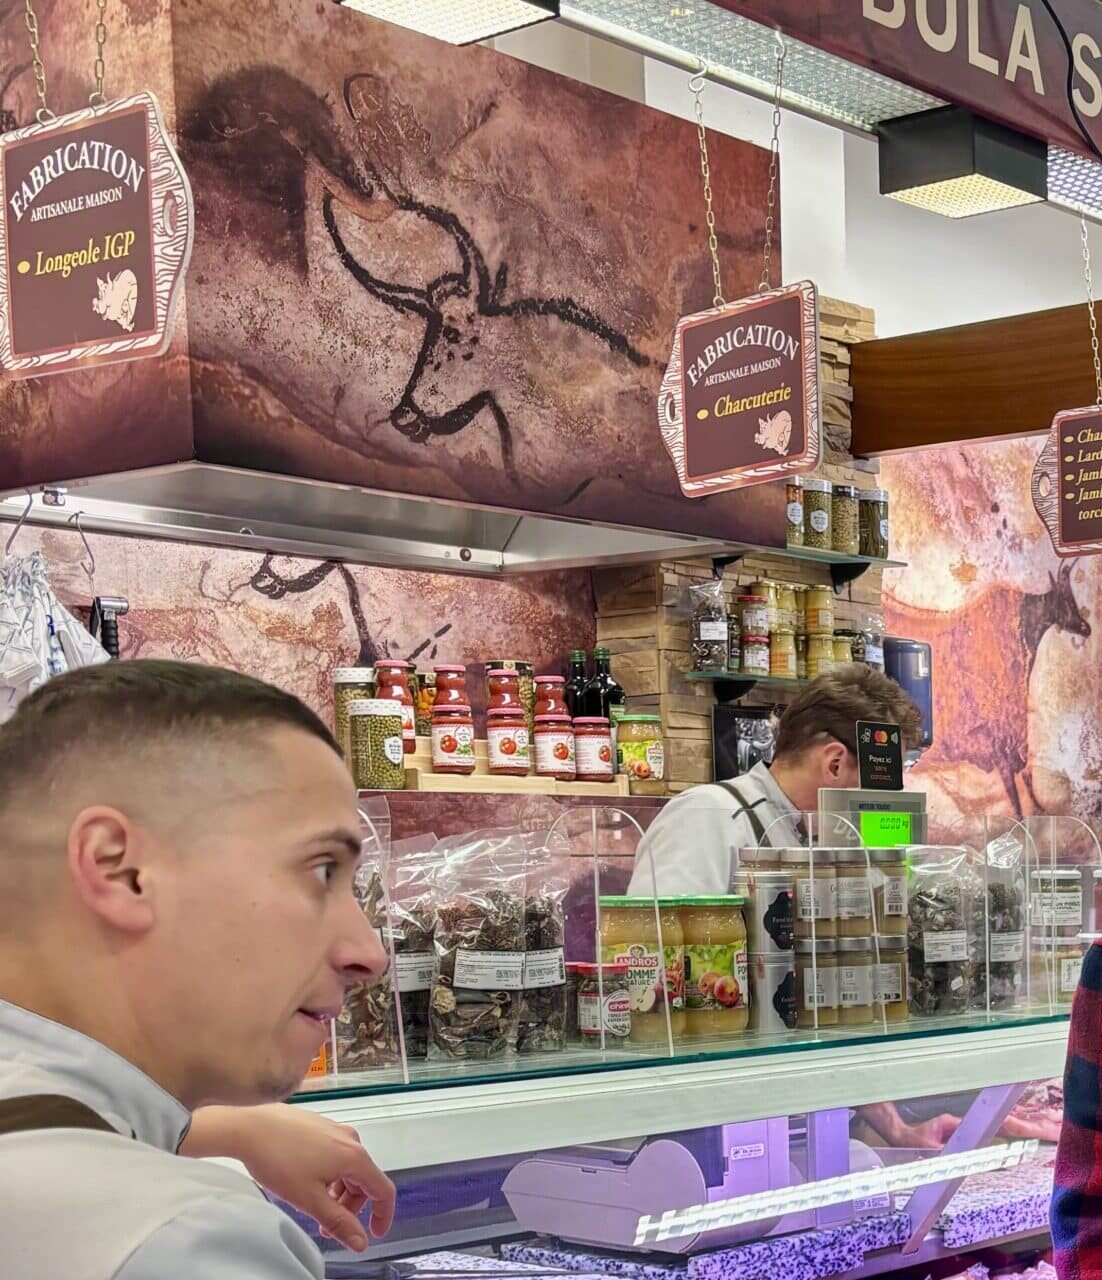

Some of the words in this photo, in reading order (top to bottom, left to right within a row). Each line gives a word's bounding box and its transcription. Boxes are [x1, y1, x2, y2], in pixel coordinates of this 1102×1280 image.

[10, 140, 145, 222] FABRICATION
[31, 196, 84, 222] ARTISANALE
[86, 187, 122, 208] MAISON
[35, 238, 100, 278] Longeole
[104, 230, 135, 260] IGP
[687, 325, 800, 387] FABRICATION
[705, 366, 749, 386] ARTISANALE
[751, 357, 781, 374] MAISON
[714, 383, 791, 417] Charcuterie
[617, 957, 658, 967] ANDROS
[626, 969, 657, 979] OMME
